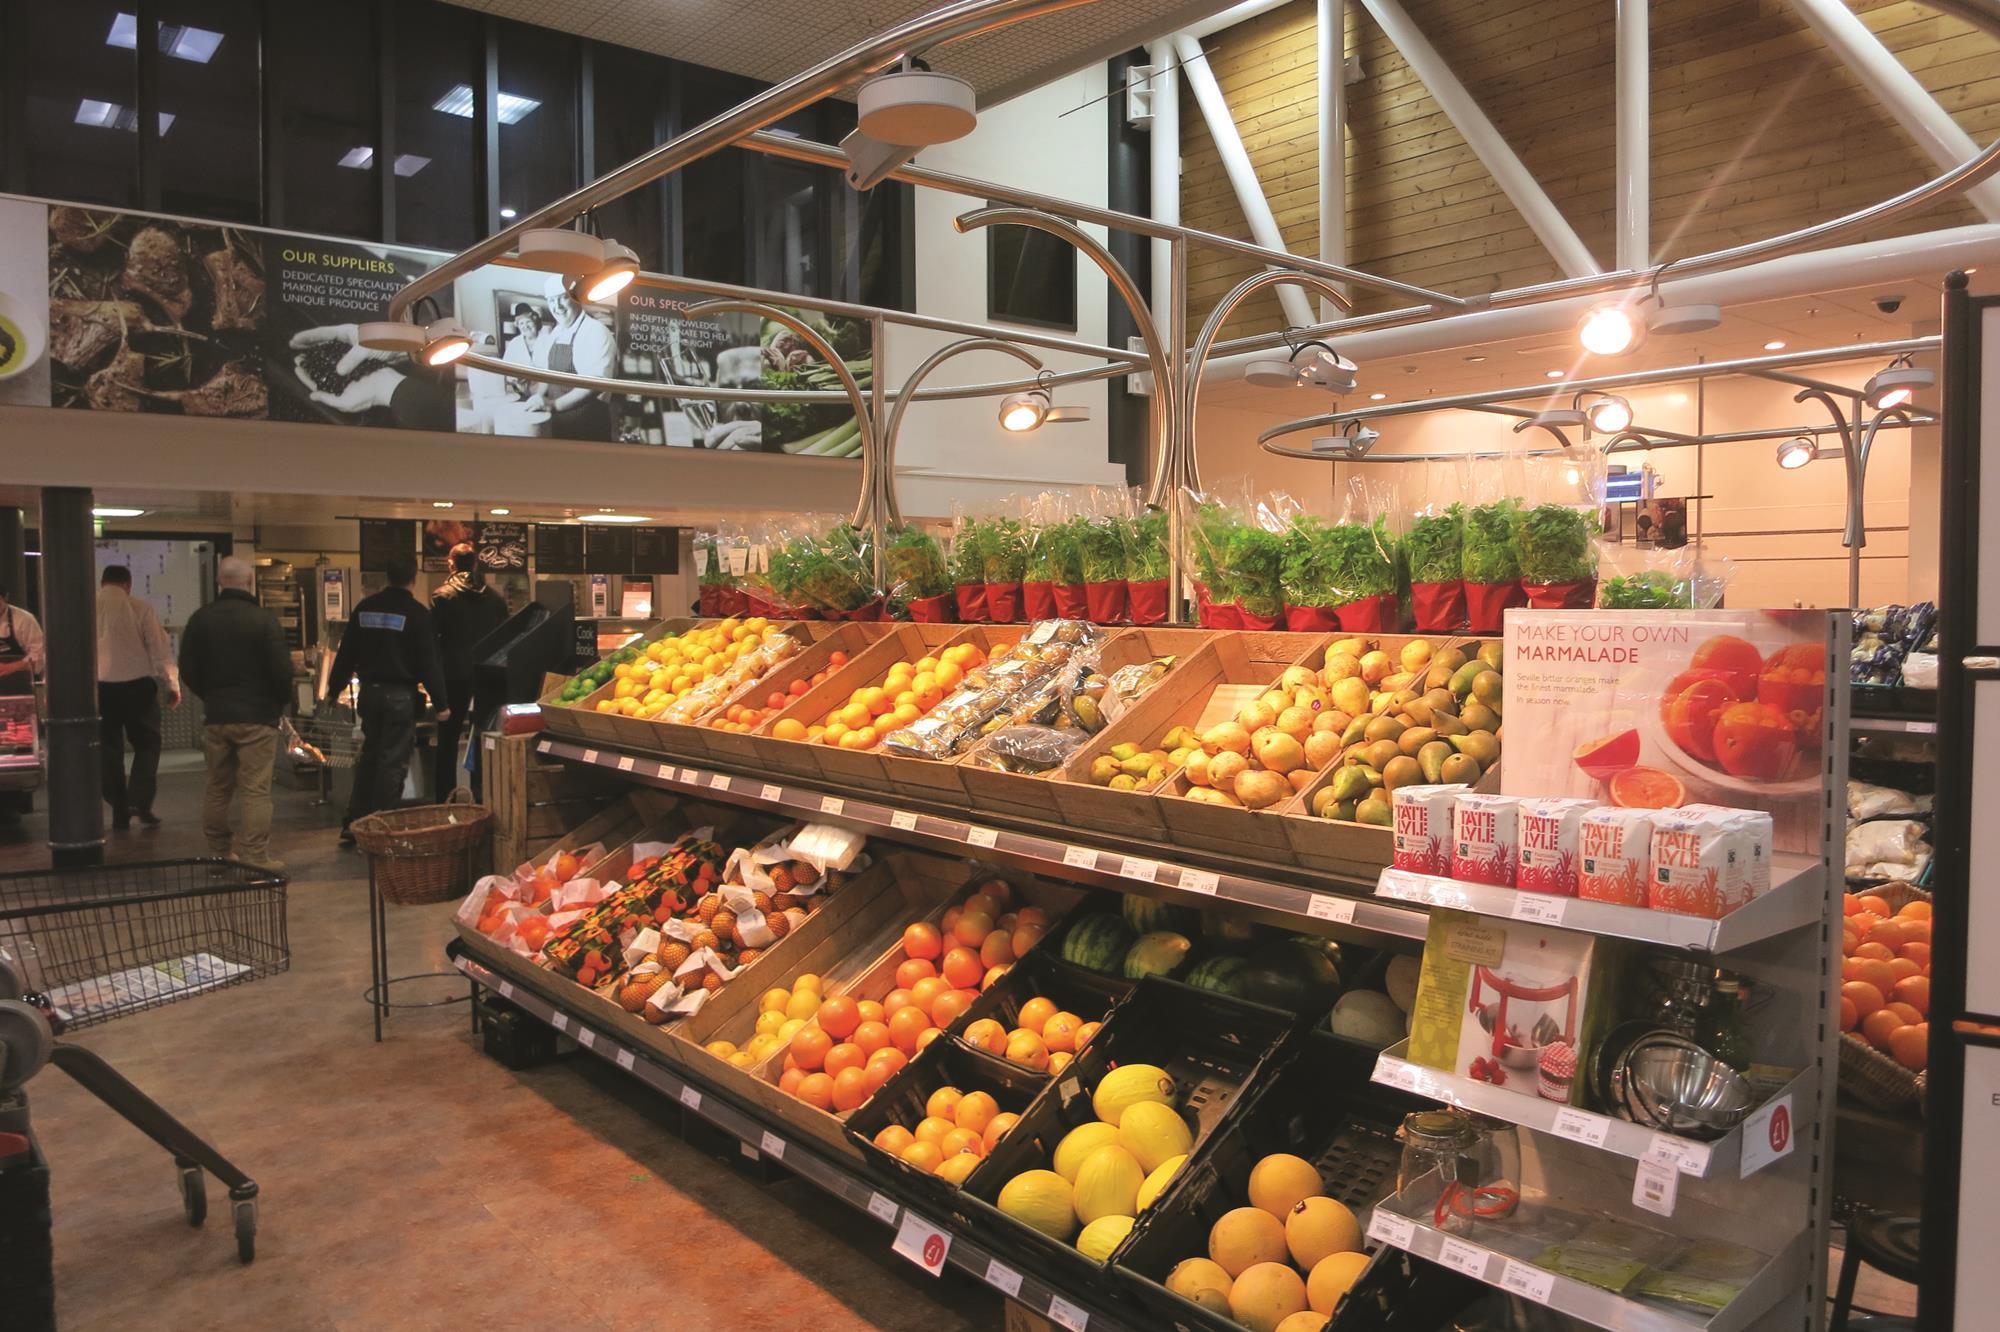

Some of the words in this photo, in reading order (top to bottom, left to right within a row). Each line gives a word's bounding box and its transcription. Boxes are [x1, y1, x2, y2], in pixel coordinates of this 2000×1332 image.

[282, 249, 317, 265] OUR
[322, 254, 395, 275] SUPPLIERS
[282, 269, 344, 286] DEDICATED
[282, 281, 326, 295] MAKING
[329, 287, 378, 301] EXCITING
[282, 293, 326, 307] UNIQUE
[329, 299, 380, 312] PRODUCE
[630, 295, 656, 308] OUR
[629, 313, 668, 325] IN-DEPTH
[630, 323, 649, 333] AND
[699, 330, 711, 339] TO
[630, 332, 648, 341] YOU
[1516, 625, 1566, 642] MAKE
[1566, 625, 1624, 643] YOUR
[1632, 625, 1689, 643] OWN
[1516, 646, 1639, 664] MARMALADE
[1516, 672, 1540, 682] Seville
[1542, 673, 1563, 682] bitter
[1598, 673, 1620, 685] make
[1516, 683, 1529, 691] the
[1394, 804, 1428, 821] TATE
[1460, 810, 1495, 828] TATE
[1397, 820, 1428, 837] LYLE
[1523, 815, 1559, 835] TATE
[1582, 822, 1623, 843] TATE
[1461, 825, 1495, 844] LYLE
[1524, 832, 1558, 851] LYLE
[1655, 830, 1700, 852] TATE
[1584, 839, 1621, 859] LYLE
[1658, 847, 1700, 869] LYLE
